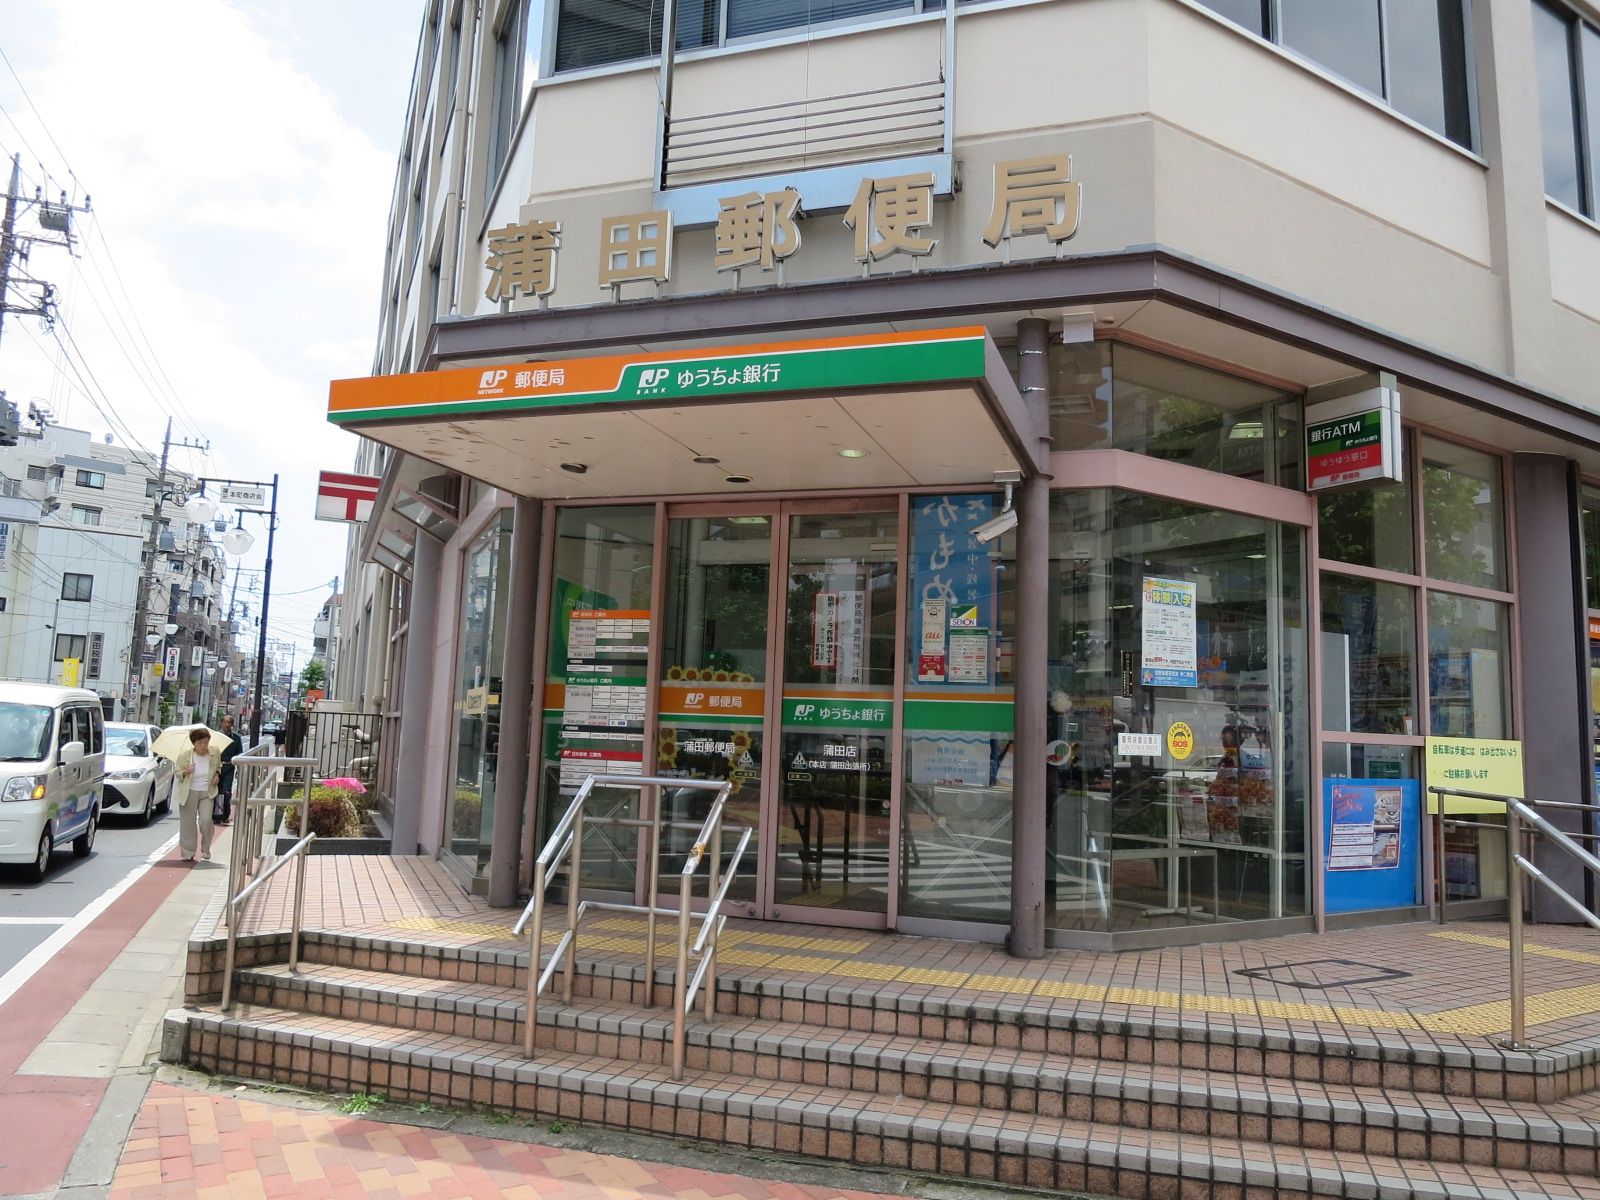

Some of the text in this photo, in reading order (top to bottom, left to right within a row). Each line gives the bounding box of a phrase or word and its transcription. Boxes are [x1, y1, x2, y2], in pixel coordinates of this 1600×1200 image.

[485, 154, 1082, 303] 蒲田郵便局
[514, 368, 565, 389] 郵便局
[677, 362, 781, 389] ゆうちょ銀行
[636, 386, 667, 395] BANK
[1310, 421, 1361, 443] 銀行ATM
[952, 618, 975, 626] SENON
[924, 631, 943, 640] au
[708, 695, 742, 708] 郵便局
[819, 707, 886, 722] ゆうちょ銀行
[683, 740, 736, 754] 蒲田郵便局
[822, 744, 857, 757] 蒲田店
[1172, 740, 1188, 748] SOS
[1432, 744, 1518, 757] 自転車は歩道には はみ出さないよう
[1443, 768, 1489, 779] に駐輪お願いします
